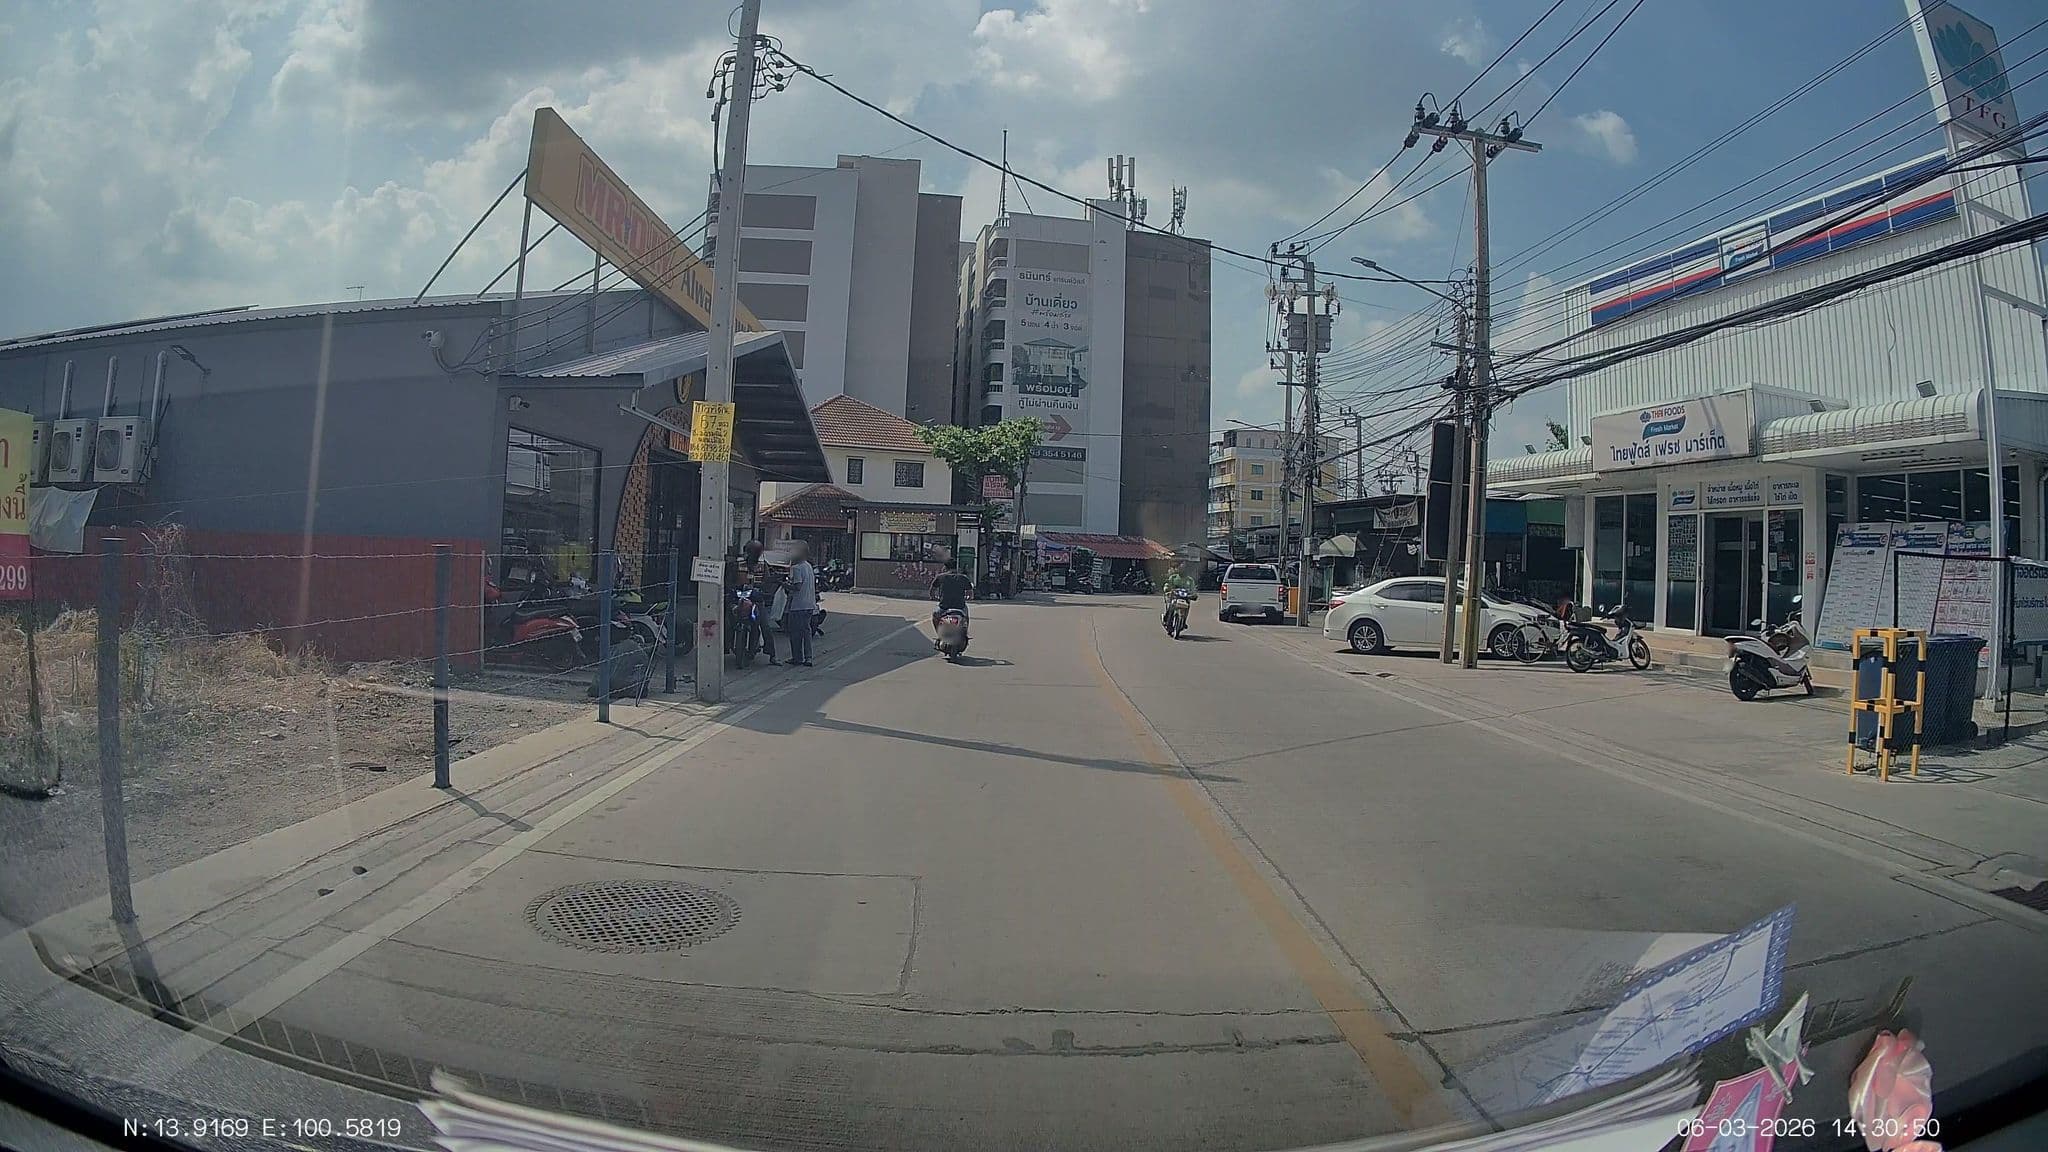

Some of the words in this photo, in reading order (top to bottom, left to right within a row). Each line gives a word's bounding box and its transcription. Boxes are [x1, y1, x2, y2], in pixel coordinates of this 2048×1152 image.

[1961, 95, 2007, 130] TFG
[681, 264, 712, 314] Alwa
[1025, 293, 1077, 309] บ้านเดี่ยว
[1026, 382, 1072, 396] พร้อมอยู่
[1664, 405, 1685, 416] FOODS
[700, 415, 717, 429] 67
[1655, 439, 1680, 457] เฟรช
[1685, 430, 1725, 453] มาร์เก็ต
